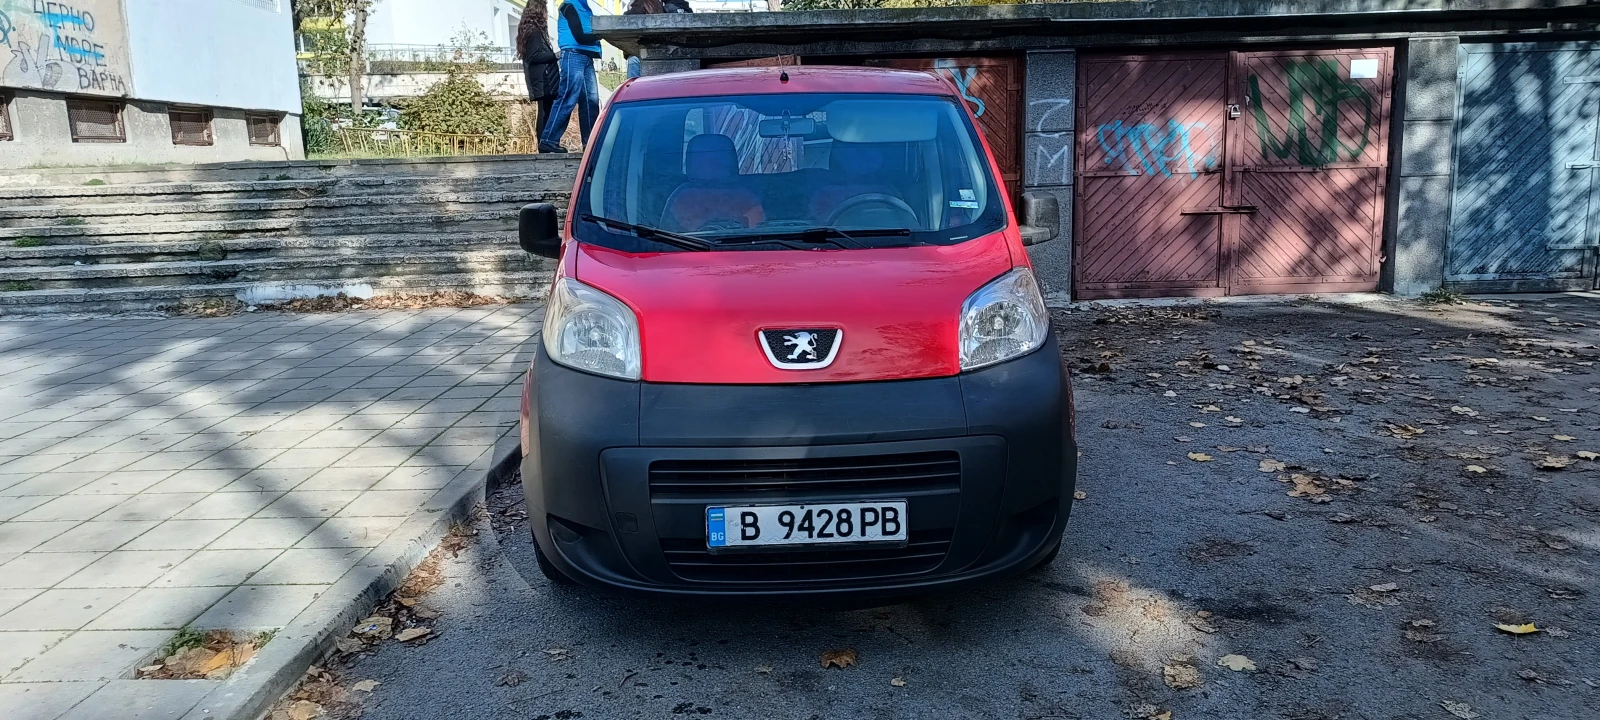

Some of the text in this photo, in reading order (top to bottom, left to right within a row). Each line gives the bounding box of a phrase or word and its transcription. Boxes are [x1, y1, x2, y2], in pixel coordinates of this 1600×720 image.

[56, 35, 107, 67] МОРЕ
[77, 66, 126, 91] ВАРНА
[711, 532, 724, 541] BG
[740, 511, 761, 541] B
